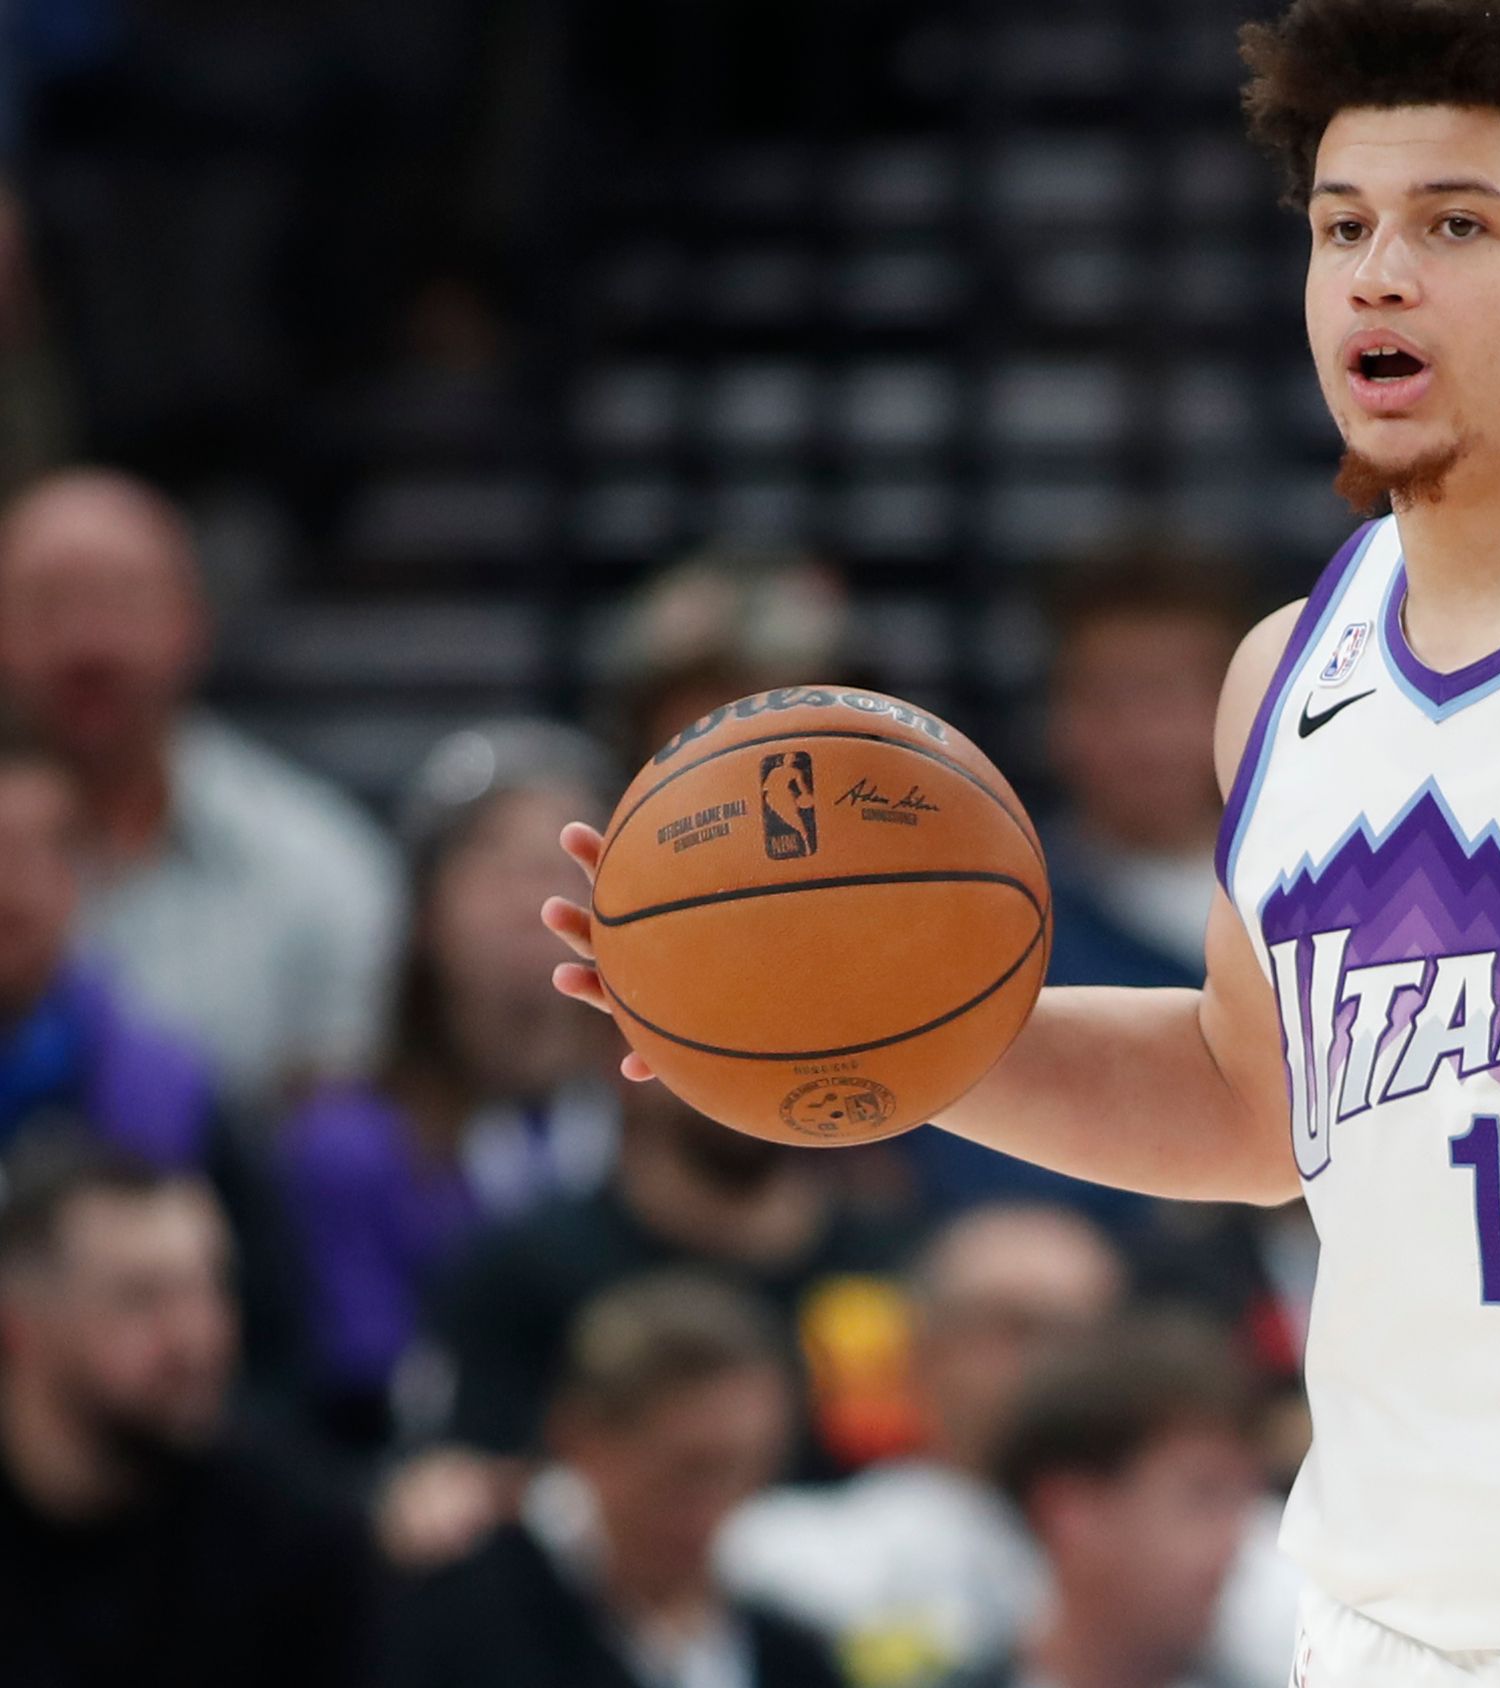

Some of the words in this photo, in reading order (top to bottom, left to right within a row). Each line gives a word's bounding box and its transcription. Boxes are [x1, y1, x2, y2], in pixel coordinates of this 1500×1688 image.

[658, 817, 693, 844] OFFICIAL
[696, 806, 721, 827] GAME
[723, 800, 747, 819] BALL
[772, 834, 799, 855] NBA
